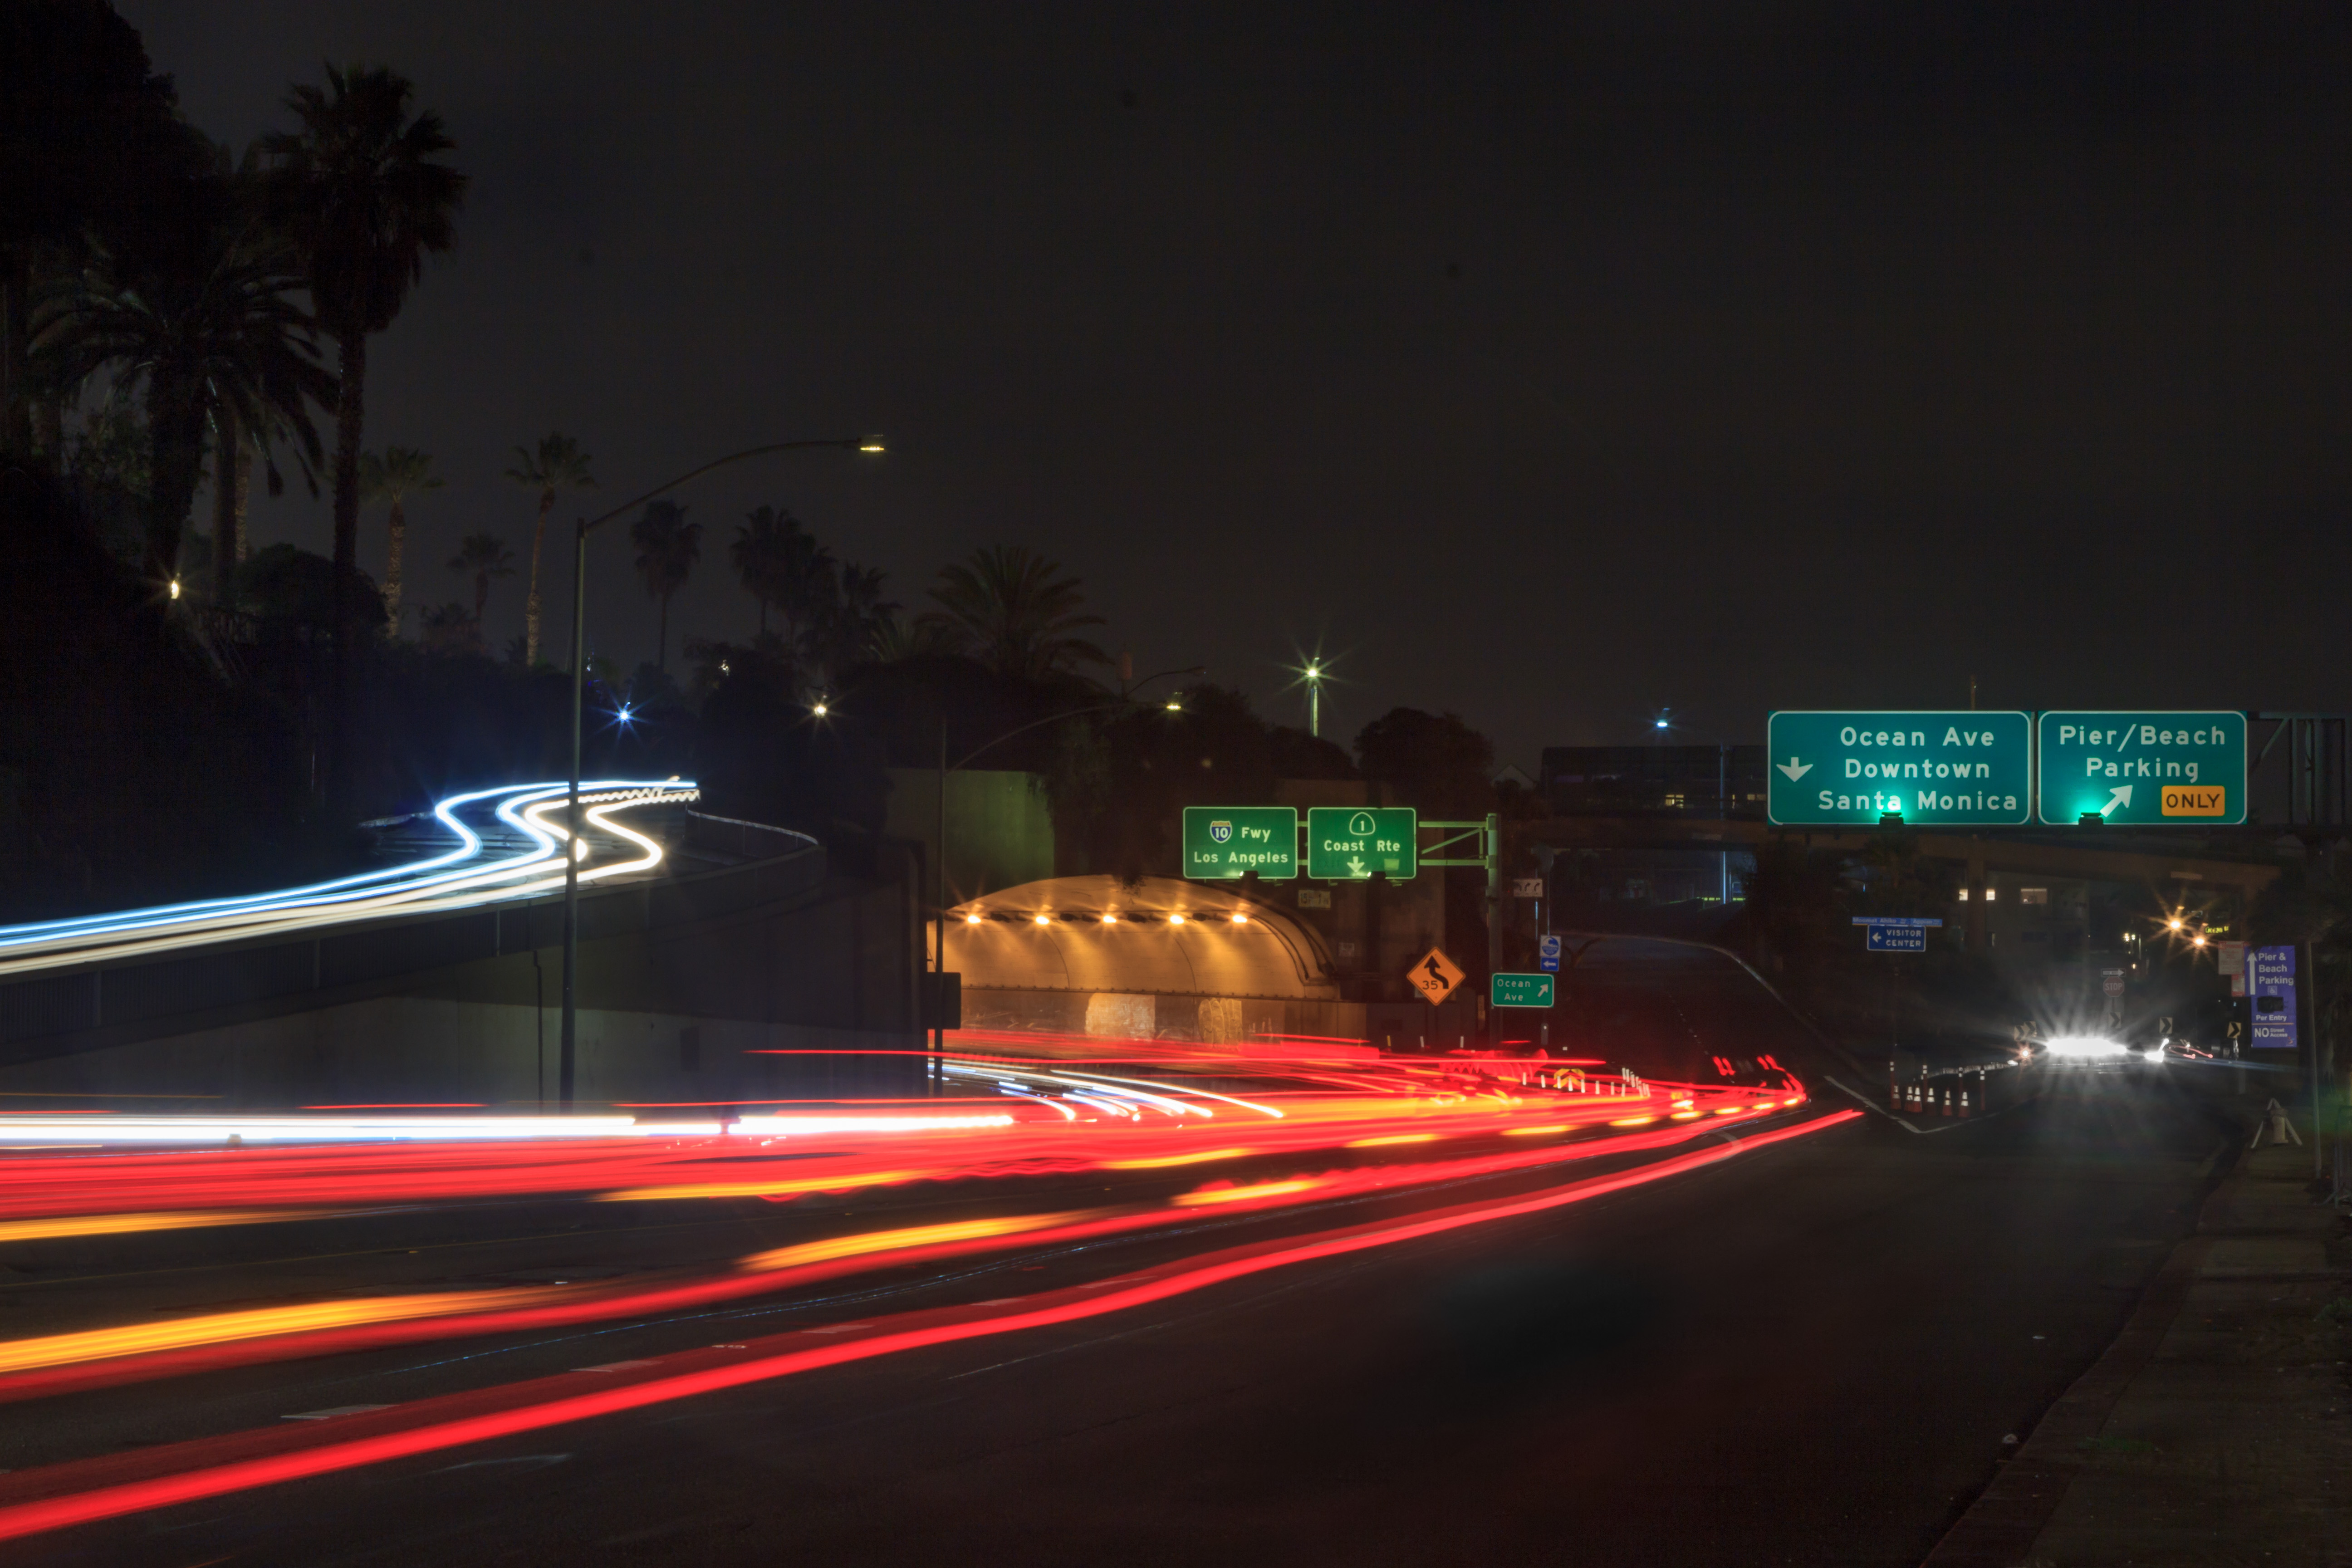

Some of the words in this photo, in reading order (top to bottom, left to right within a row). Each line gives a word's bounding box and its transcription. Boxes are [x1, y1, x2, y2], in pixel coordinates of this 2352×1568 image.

[1840, 726, 1925, 746] Ocean
[1942, 726, 1994, 746] Ave
[2060, 724, 2225, 752] Pier/Beach
[1845, 759, 1990, 778] Downtown
[2087, 758, 2199, 784] Parking
[1818, 790, 1901, 811] Santa
[1918, 790, 2017, 810] Monica
[2166, 794, 2220, 808] ONLY
[1360, 820, 1365, 831] 1
[1215, 827, 1229, 838] 10
[1241, 827, 1271, 843] Fwy
[1324, 840, 1365, 851] Coast
[1377, 840, 1401, 851] Rte
[1194, 852, 1219, 862] Los
[1228, 852, 1288, 867] Angeles
[2258, 953, 2277, 961] Pier
[2279, 952, 2286, 960] &
[2259, 964, 2288, 972] Beach
[1422, 980, 1438, 990] 35
[1497, 978, 1531, 988] Ocean
[2259, 976, 2294, 986] Parking
[1504, 992, 1524, 1001] Ave
[2254, 1027, 2269, 1038] NO
